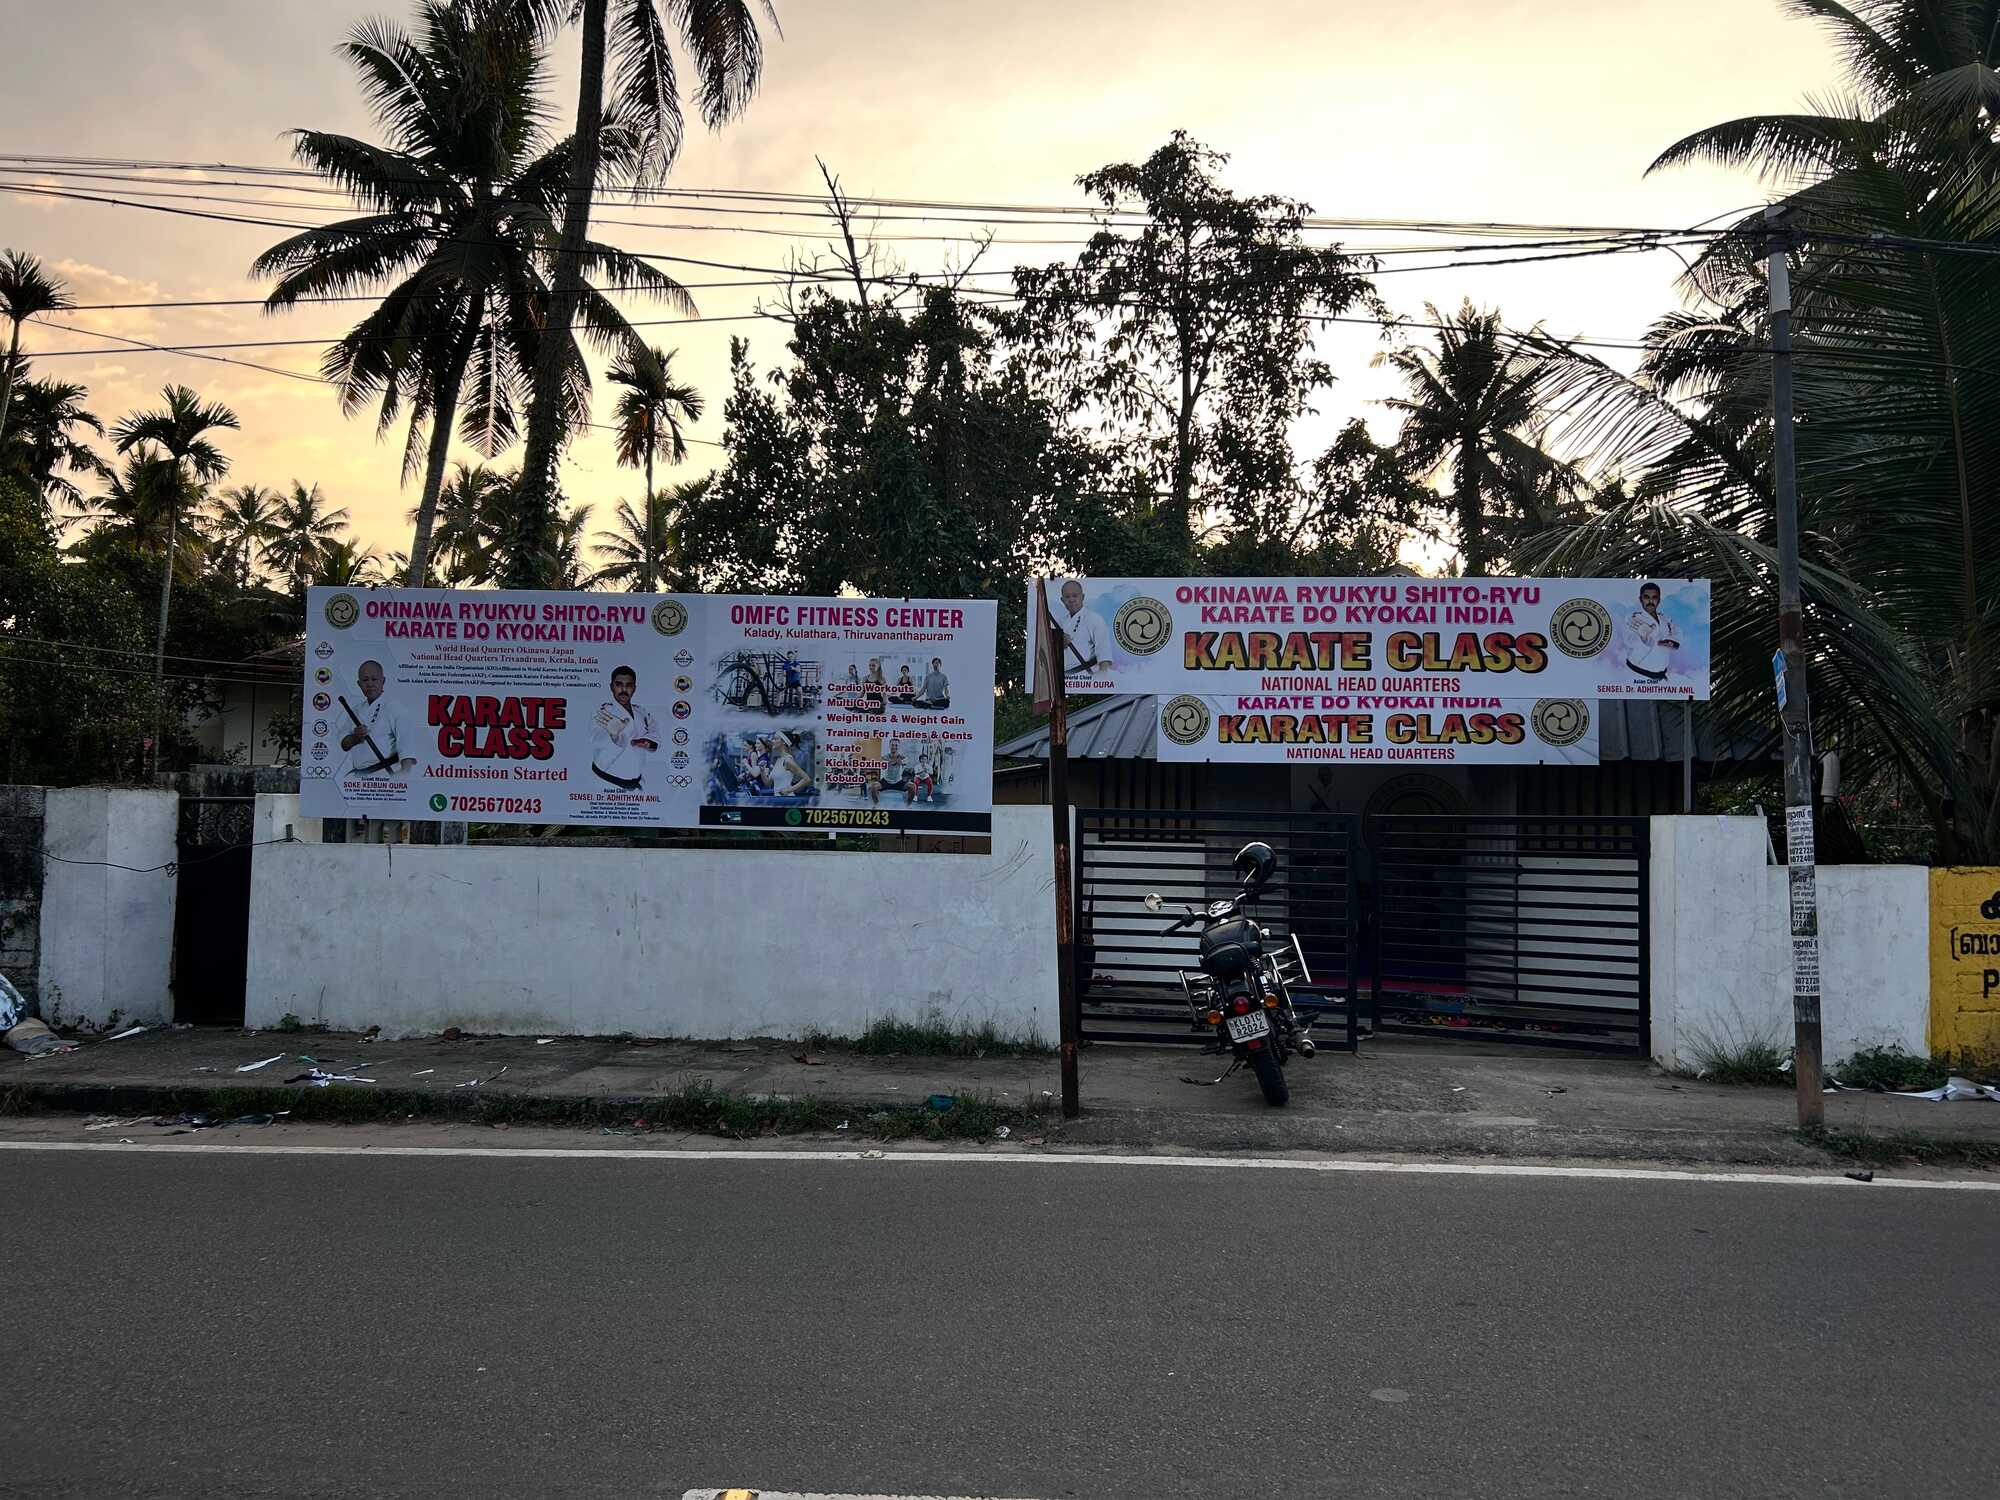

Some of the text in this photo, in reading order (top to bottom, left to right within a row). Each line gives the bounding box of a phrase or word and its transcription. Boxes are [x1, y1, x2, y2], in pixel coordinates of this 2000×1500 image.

[1176, 586, 1540, 604] OKINAWA RYUKYU SHITO-RYU
[366, 601, 453, 620] OKINAWA
[459, 603, 536, 622] RYUKYU
[542, 604, 646, 624] SHITO-RYU
[731, 605, 964, 629] OMFC FITNESS CENTER
[1201, 606, 1514, 624] KARATE DO KYOKAI INDIA
[385, 621, 625, 642] KARATE DO KYOKAI INDIA
[744, 628, 953, 643] Kalady, Kulathara, Thiruvananthapuram
[411, 652, 441, 661] National
[444, 653, 462, 661] Head
[466, 654, 498, 662] Quarters
[579, 656, 598, 664] India
[460, 645, 479, 653] Head
[482, 646, 514, 654] Quarters
[552, 648, 574, 656] Japan
[1184, 632, 1549, 673] KARATE CLASS
[827, 683, 914, 694] Cardio Workouts
[1261, 676, 1460, 694] NATIONAL HEAD QUARTERS
[856, 698, 880, 710] Gym
[1238, 696, 1502, 710] KARATE DO KYOKAI INDIA
[427, 694, 566, 730] KARATE
[826, 714, 965, 726] Weight loss & Weight Gain
[826, 729, 972, 740] Training For Ladies & Gents
[1218, 714, 1373, 744] KARATE
[1386, 714, 1526, 744] CLASS
[438, 726, 556, 760] CLASS
[826, 744, 862, 753] Karate
[1287, 748, 1454, 760] NATIONAL HEAD QUARTERS
[825, 758, 888, 770] Kick Boxing
[424, 764, 568, 782] Addmission Started
[824, 774, 865, 784] Kobudo
[450, 795, 542, 814] 7025670243
[806, 810, 890, 826] 7025670243
